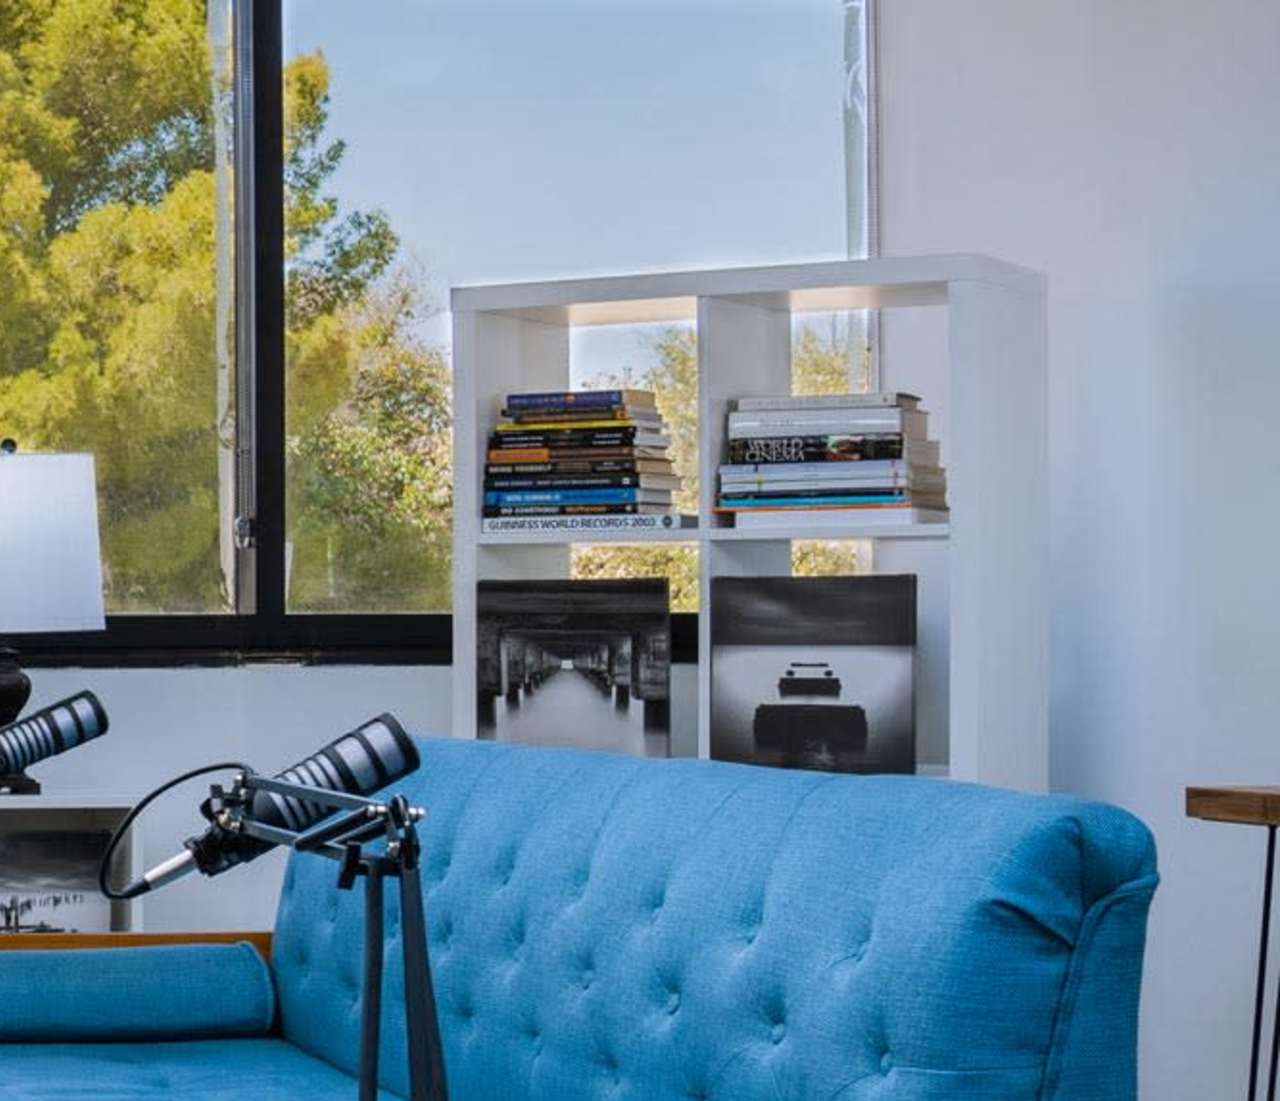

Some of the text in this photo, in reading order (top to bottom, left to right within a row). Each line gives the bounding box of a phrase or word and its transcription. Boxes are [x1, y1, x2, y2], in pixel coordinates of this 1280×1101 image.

[744, 437, 804, 450] WORLD
[744, 450, 805, 462] CINEMA
[488, 517, 540, 530] GUINNESS
[541, 516, 578, 529] WORLD
[579, 516, 629, 529] RECORDS
